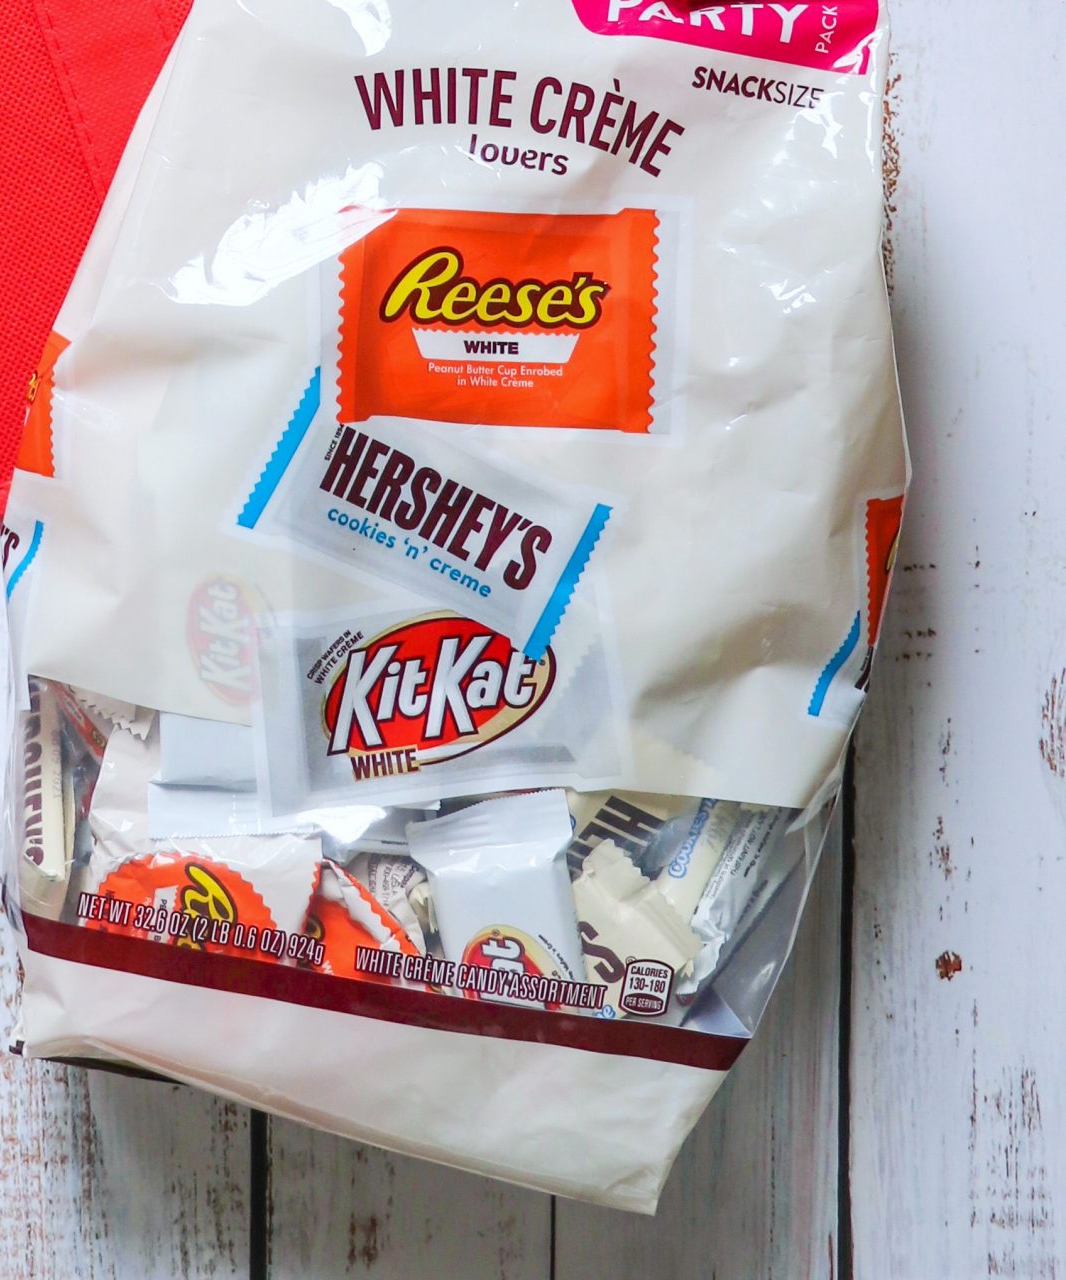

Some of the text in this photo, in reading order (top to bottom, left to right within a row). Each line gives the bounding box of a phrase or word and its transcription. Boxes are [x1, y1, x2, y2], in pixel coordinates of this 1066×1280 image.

[815, 5, 838, 54] PACK
[354, 67, 686, 179] WHITE CRÈME
[468, 133, 570, 177] lovers
[380, 245, 613, 329] Reese's
[463, 340, 520, 355] WHITE
[428, 362, 564, 377] Peanut Butter Cup Enrobed
[457, 376, 535, 388] in White Crème
[324, 439, 338, 461] SINCE
[319, 425, 554, 592] HERSHEY'S
[327, 506, 398, 551] cookies
[429, 556, 493, 599] creme
[320, 635, 346, 661] WAFERS
[314, 656, 338, 685] WHITE
[350, 747, 423, 781] WHITE
[77, 893, 106, 920] NET
[108, 900, 132, 926] WT
[134, 905, 168, 933] 32.6
[170, 913, 189, 937] OZ
[192, 917, 209, 941] (2
[211, 923, 230, 944] LB
[234, 927, 256, 949] 0.6
[260, 930, 286, 956] OZ)
[288, 936, 325, 965] 924g
[356, 947, 402, 977] WHITE
[404, 954, 454, 986] CRÈME
[458, 967, 509, 996] CANDY
[510, 974, 607, 1008] ASSORTMENT
[629, 977, 666, 994] 130-180
[630, 965, 669, 979] CALORIES
[625, 997, 663, 1011] PER SERVING
